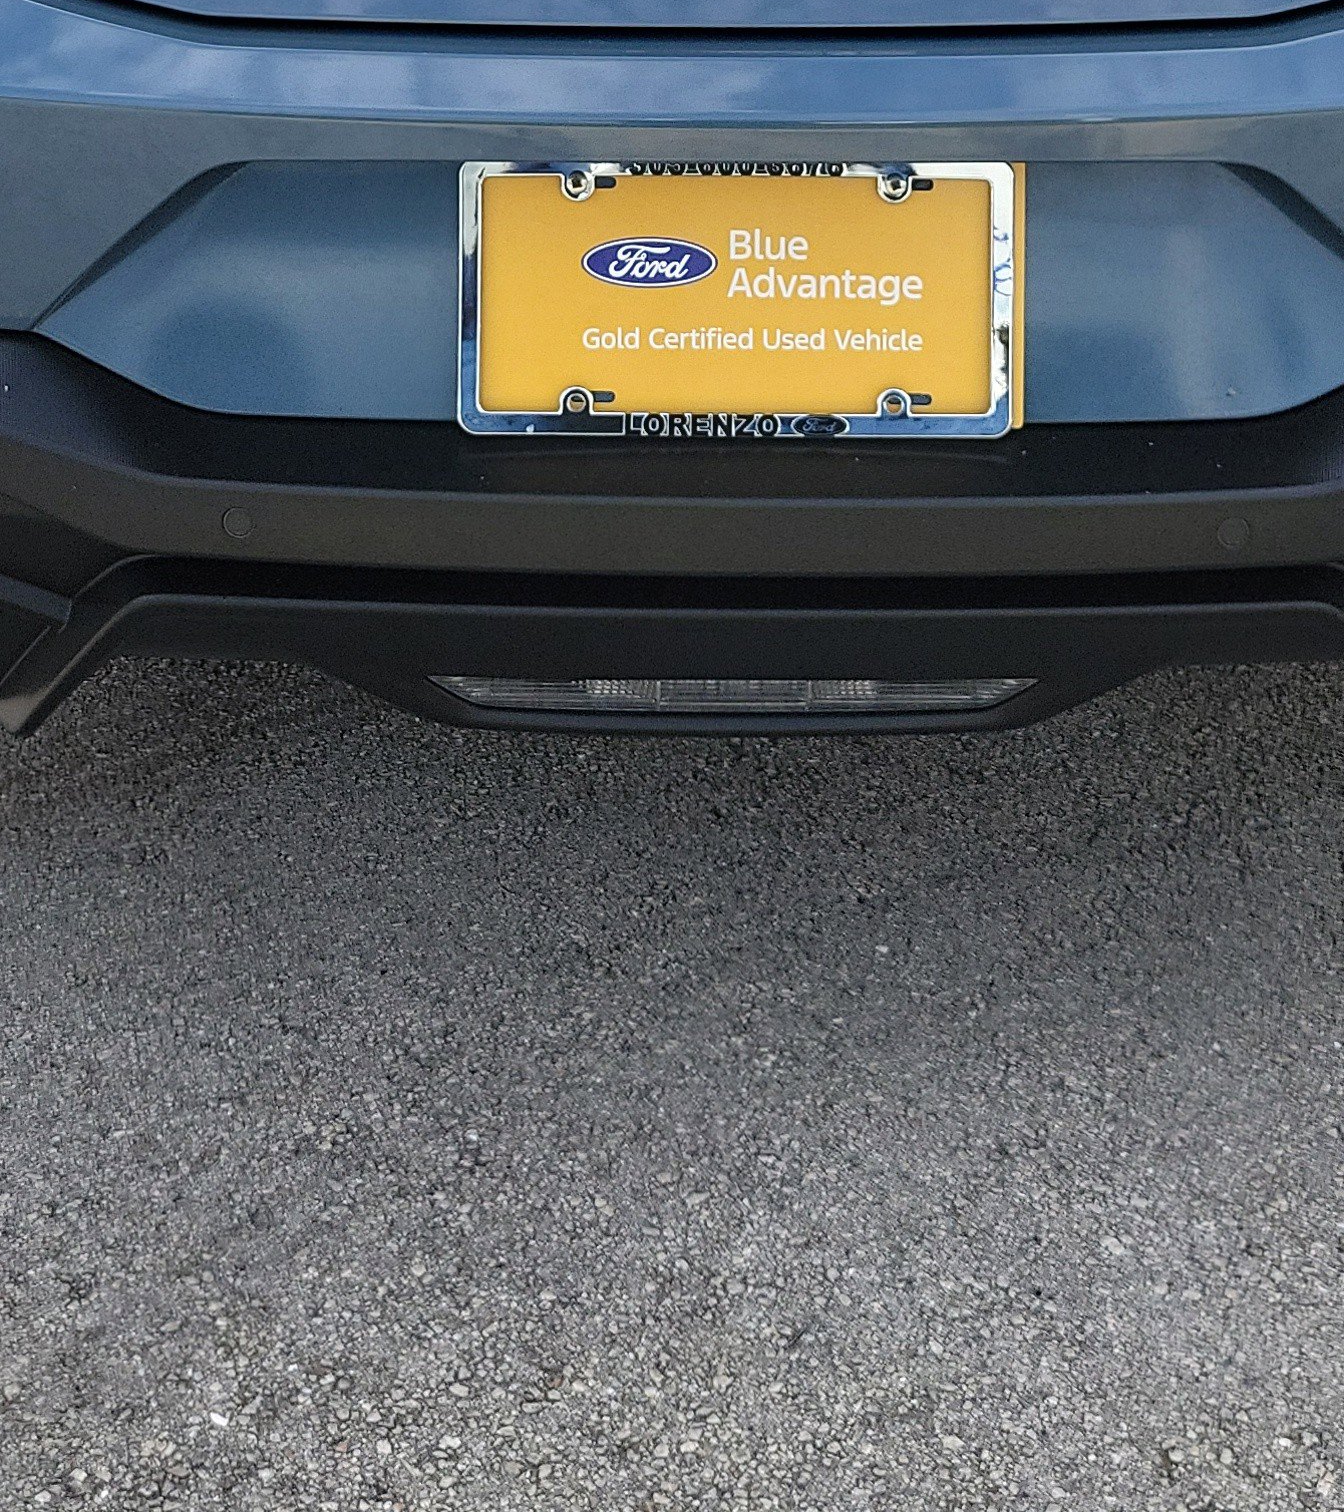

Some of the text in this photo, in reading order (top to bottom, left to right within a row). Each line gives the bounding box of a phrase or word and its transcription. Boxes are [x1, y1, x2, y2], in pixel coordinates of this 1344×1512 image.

[728, 228, 809, 261] Blue
[608, 243, 691, 280] Ford
[726, 266, 924, 306] Advantage
[581, 326, 924, 352] Gold Certified Used Vehicle
[625, 412, 779, 437] LORENZO
